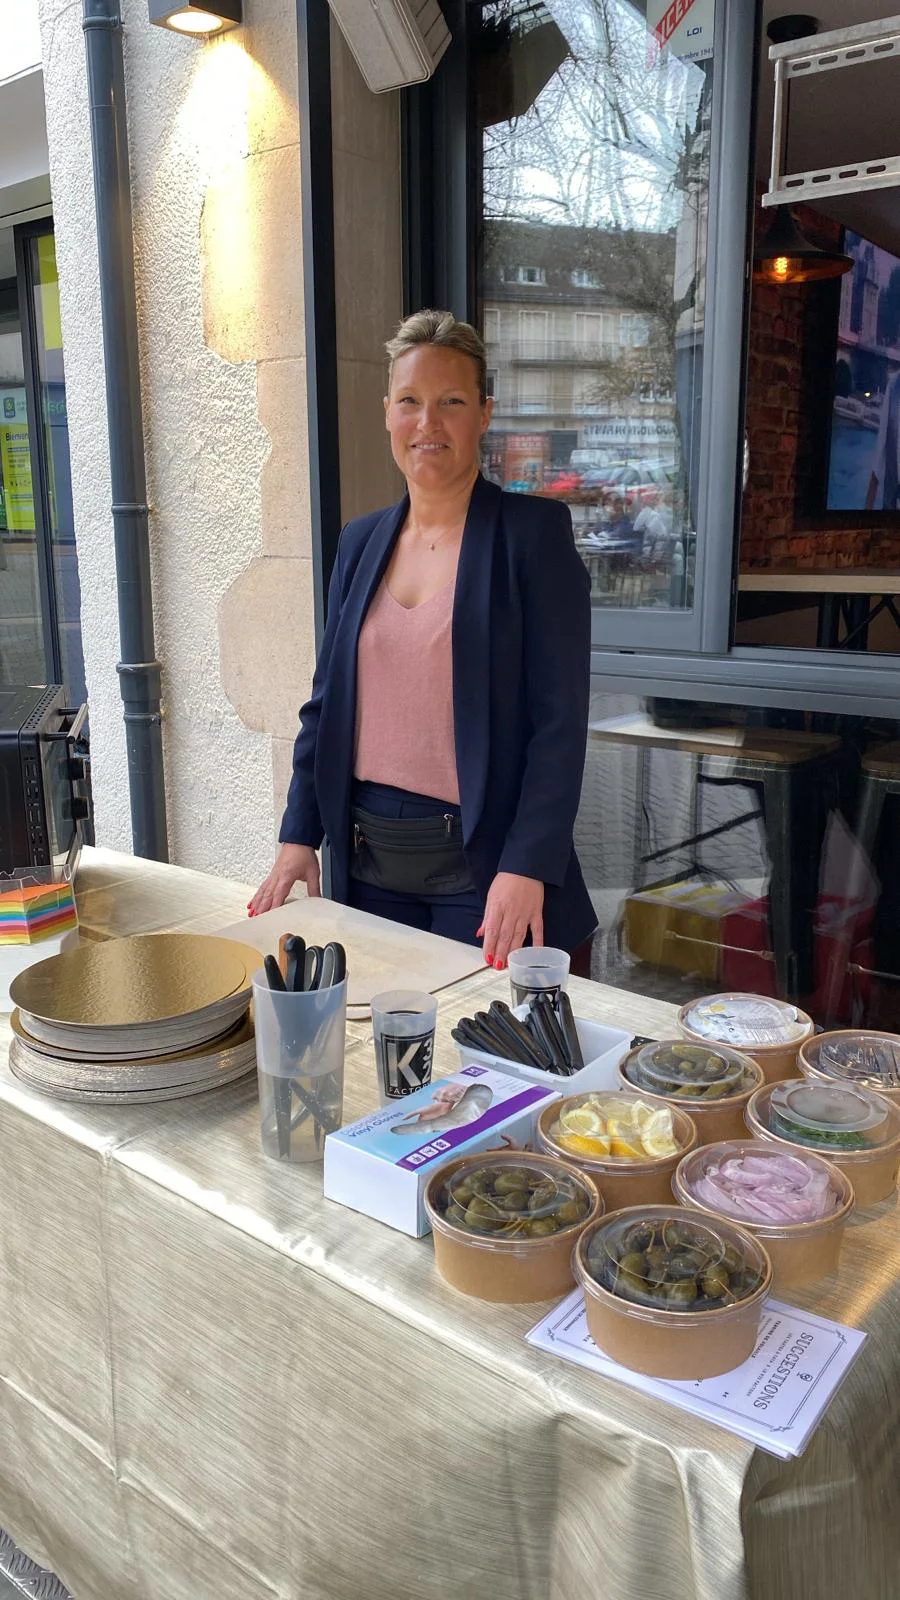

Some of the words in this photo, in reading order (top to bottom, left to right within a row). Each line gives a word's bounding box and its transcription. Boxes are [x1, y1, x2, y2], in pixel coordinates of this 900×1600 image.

[687, 27, 702, 36] LOI
[348, 1125, 374, 1138] Vinyl
[372, 1111, 404, 1127] Gloves
[753, 1332, 814, 1410] SUGGESTIONS
